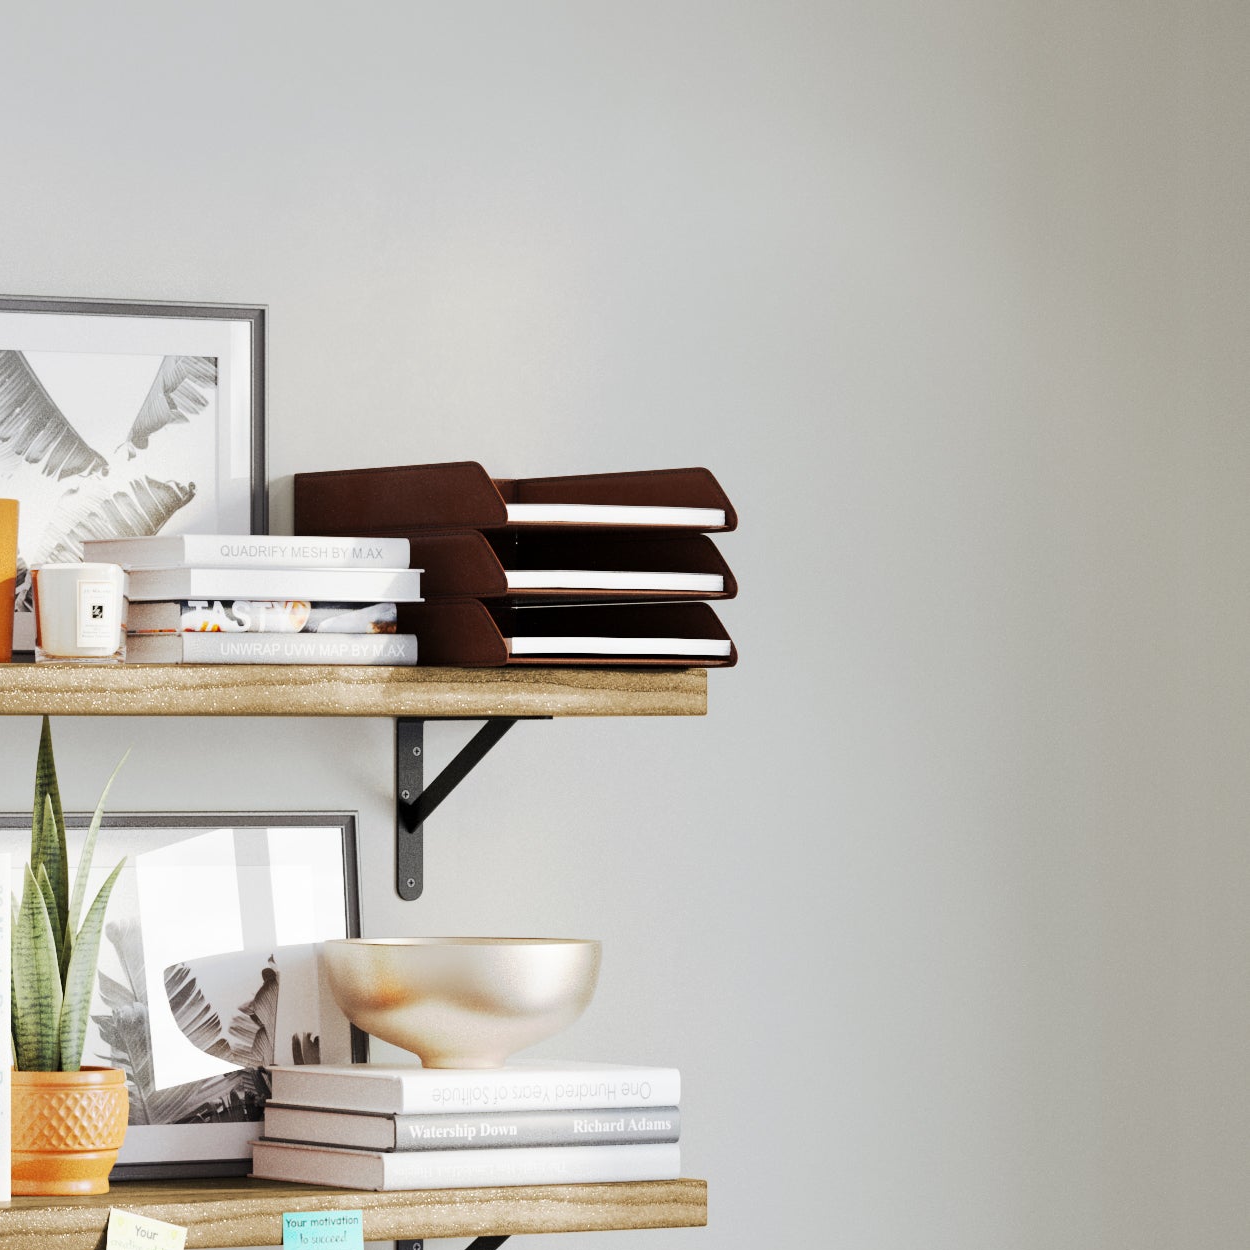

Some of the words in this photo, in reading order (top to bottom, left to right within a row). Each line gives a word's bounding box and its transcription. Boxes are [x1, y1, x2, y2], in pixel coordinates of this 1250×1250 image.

[220, 544, 287, 560] QUADRIFY
[292, 546, 328, 560] MESH
[331, 546, 348, 560] BY
[352, 547, 383, 560] M.AX
[188, 600, 294, 632] TASTY
[220, 642, 280, 658] UNWRAP
[284, 642, 316, 658] UVW
[319, 643, 349, 658] MAP
[352, 643, 370, 658] BY
[374, 643, 406, 658] M.AX
[432, 1084, 489, 1103] Solitude
[492, 1084, 508, 1104] of
[511, 1084, 550, 1102] Years
[554, 1082, 616, 1100] Hundred
[621, 1081, 652, 1100] One
[409, 1125, 476, 1140] Watership
[480, 1124, 517, 1137] Down
[573, 1119, 624, 1133] Richard
[627, 1118, 672, 1132] Adams
[286, 1219, 308, 1228] Your
[310, 1217, 358, 1226] motivation
[136, 1225, 158, 1240] Your
